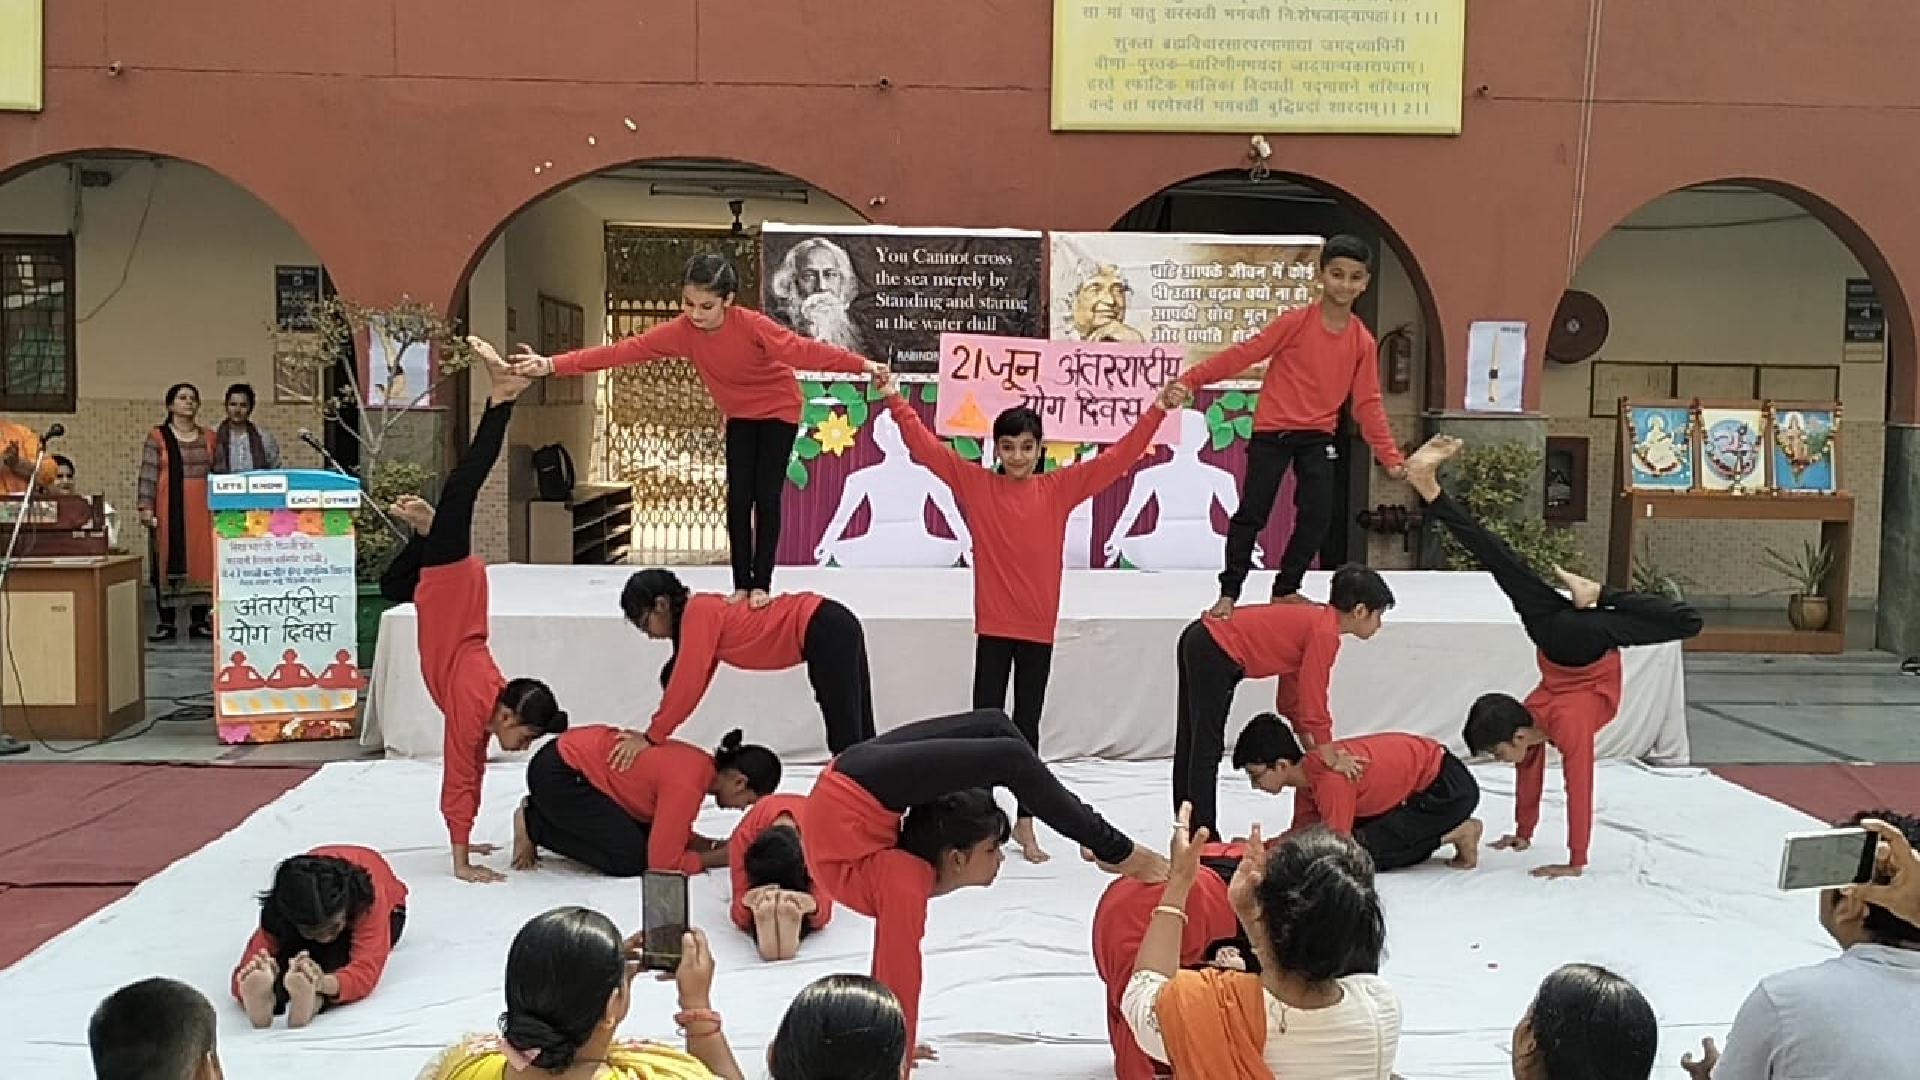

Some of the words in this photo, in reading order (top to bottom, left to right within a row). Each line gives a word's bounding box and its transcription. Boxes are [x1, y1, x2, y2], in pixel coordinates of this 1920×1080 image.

[876, 247, 908, 264] You
[913, 248, 970, 265] Cannot
[973, 253, 1013, 265] cross
[875, 270, 901, 286] the
[903, 275, 929, 286] sea
[932, 271, 986, 289] merely
[989, 270, 1009, 290] by
[875, 292, 943, 311] Standing
[945, 293, 974, 308] and
[978, 294, 1028, 313] staring
[875, 317, 889, 329] at
[893, 314, 919, 330] the
[921, 315, 963, 331] water
[966, 315, 997, 331] dull
[1075, 387, 1144, 427] दिवस
[228, 618, 272, 646] योग
[281, 616, 339, 643] दिवस
